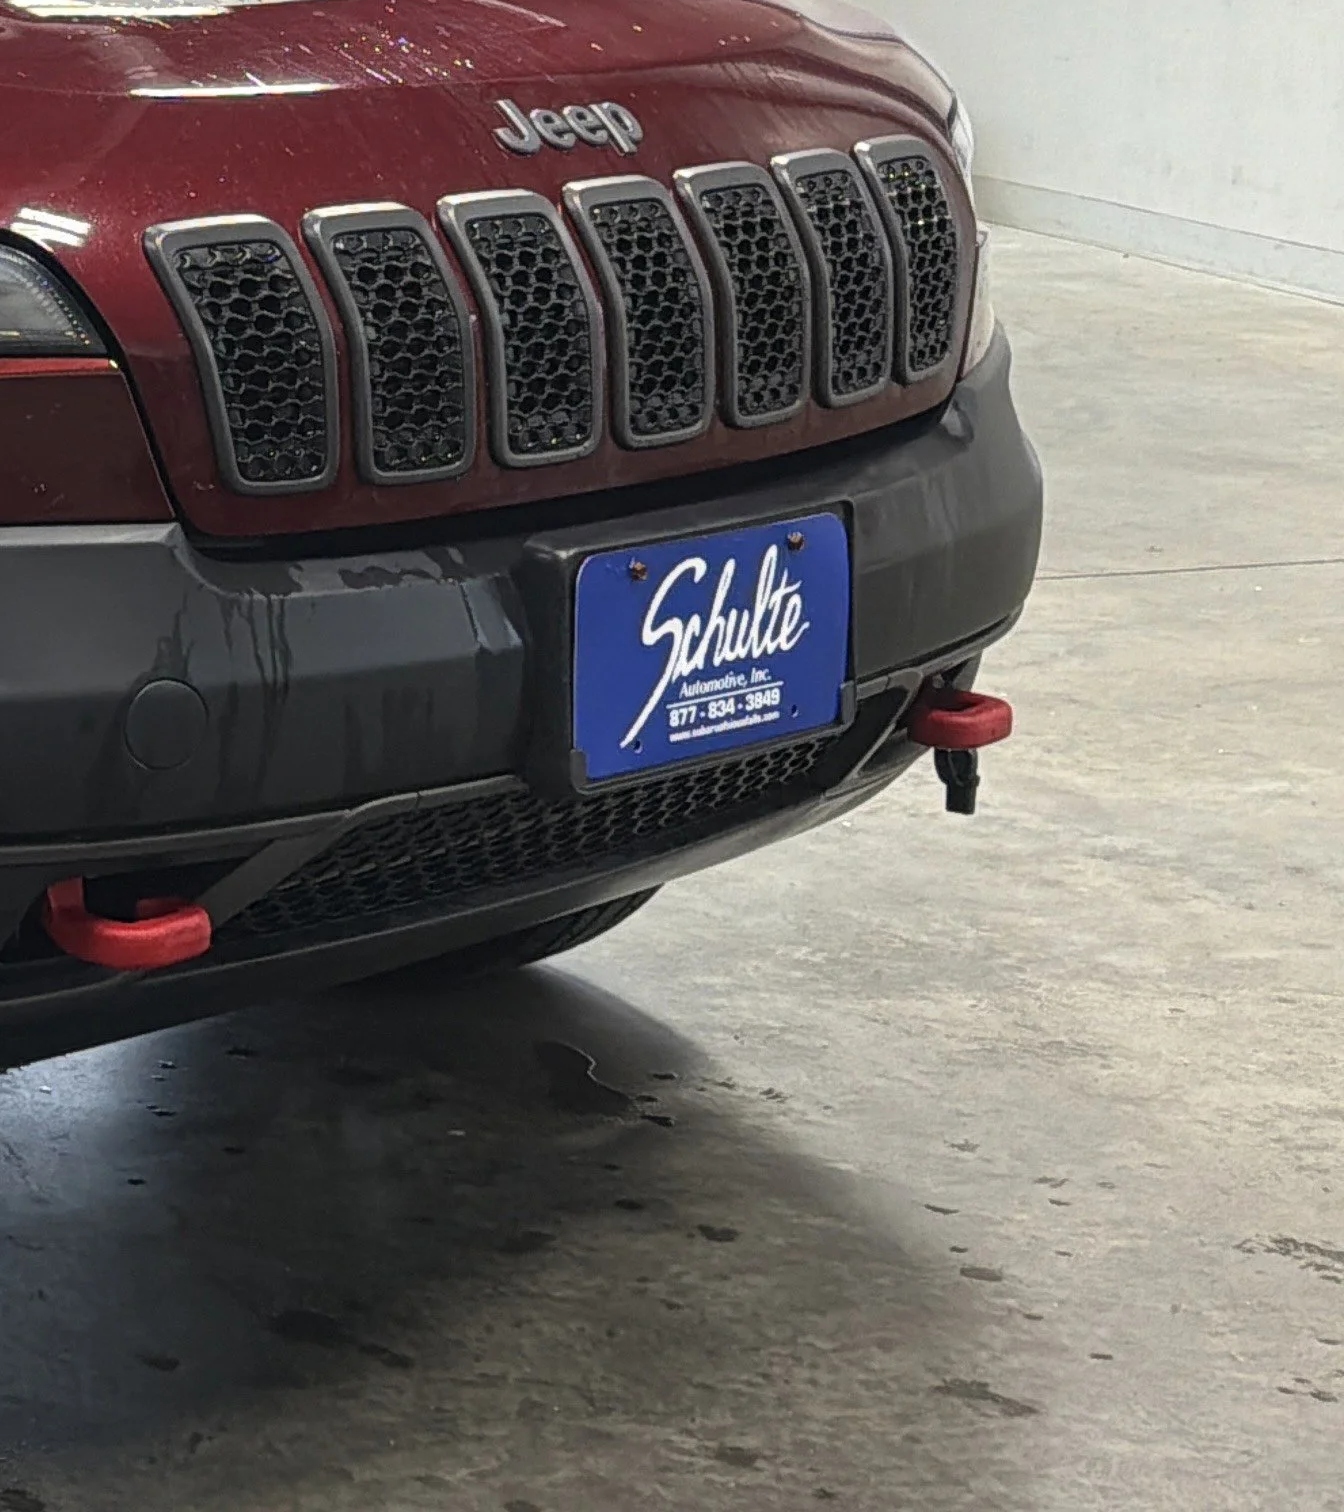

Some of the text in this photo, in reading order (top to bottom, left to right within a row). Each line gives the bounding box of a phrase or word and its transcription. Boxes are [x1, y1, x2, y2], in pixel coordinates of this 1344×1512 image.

[491, 98, 644, 158] Jeep
[619, 543, 811, 750] Schulte
[750, 667, 772, 684] Inc.
